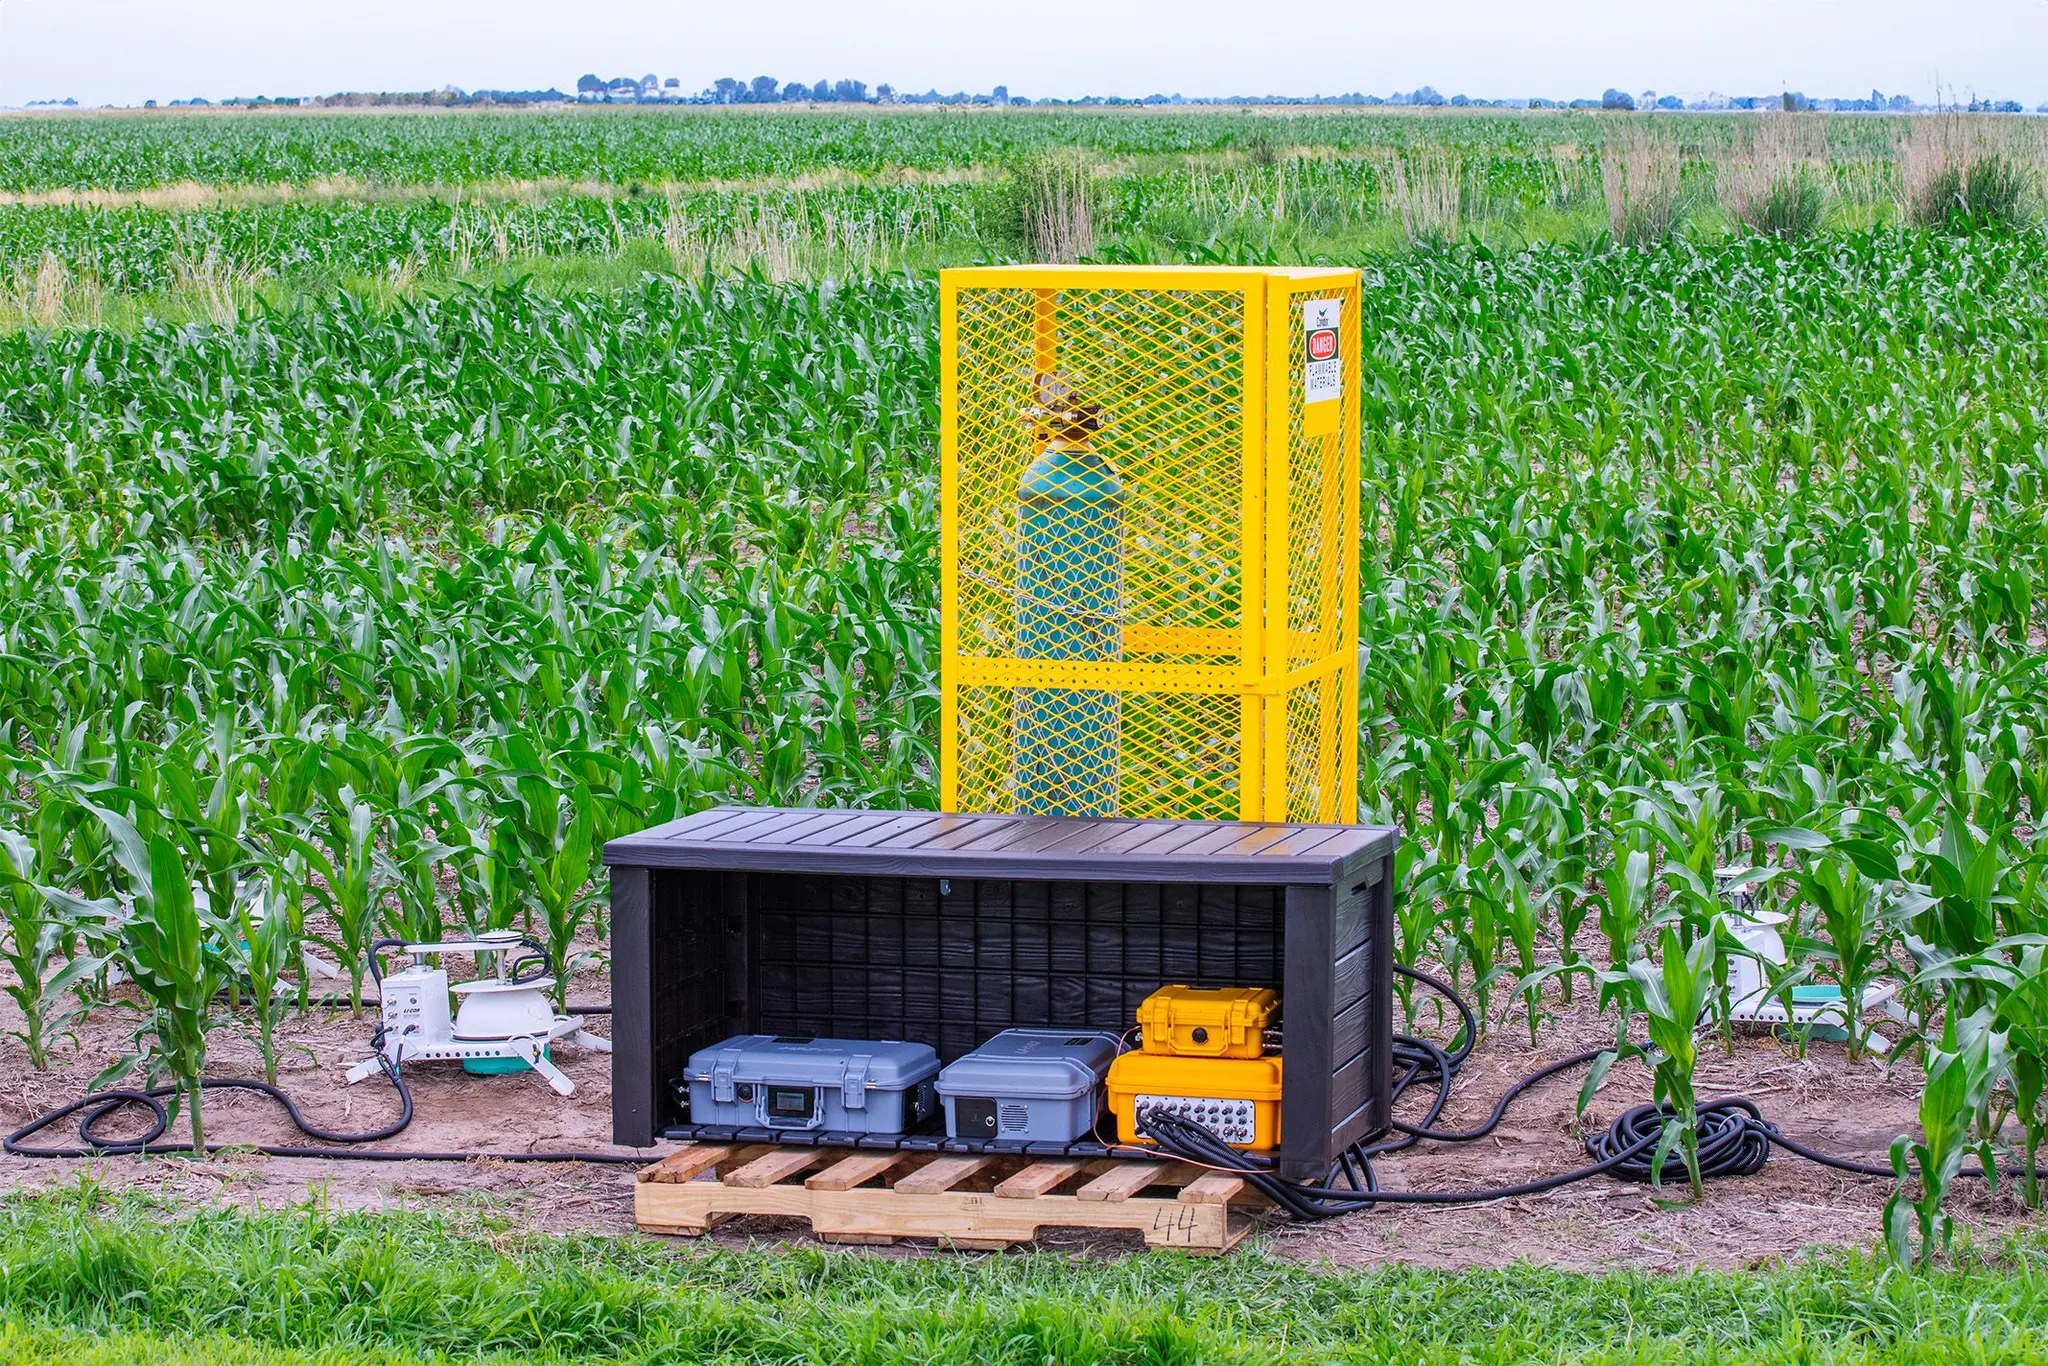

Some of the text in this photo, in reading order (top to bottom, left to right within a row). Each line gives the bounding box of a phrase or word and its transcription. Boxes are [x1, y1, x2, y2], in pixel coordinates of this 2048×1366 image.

[1312, 335, 1333, 354] DANGER
[1309, 360, 1337, 376] FLAMMABLE
[1310, 374, 1336, 390] MATERIALS
[1153, 1205, 1198, 1242] 44
